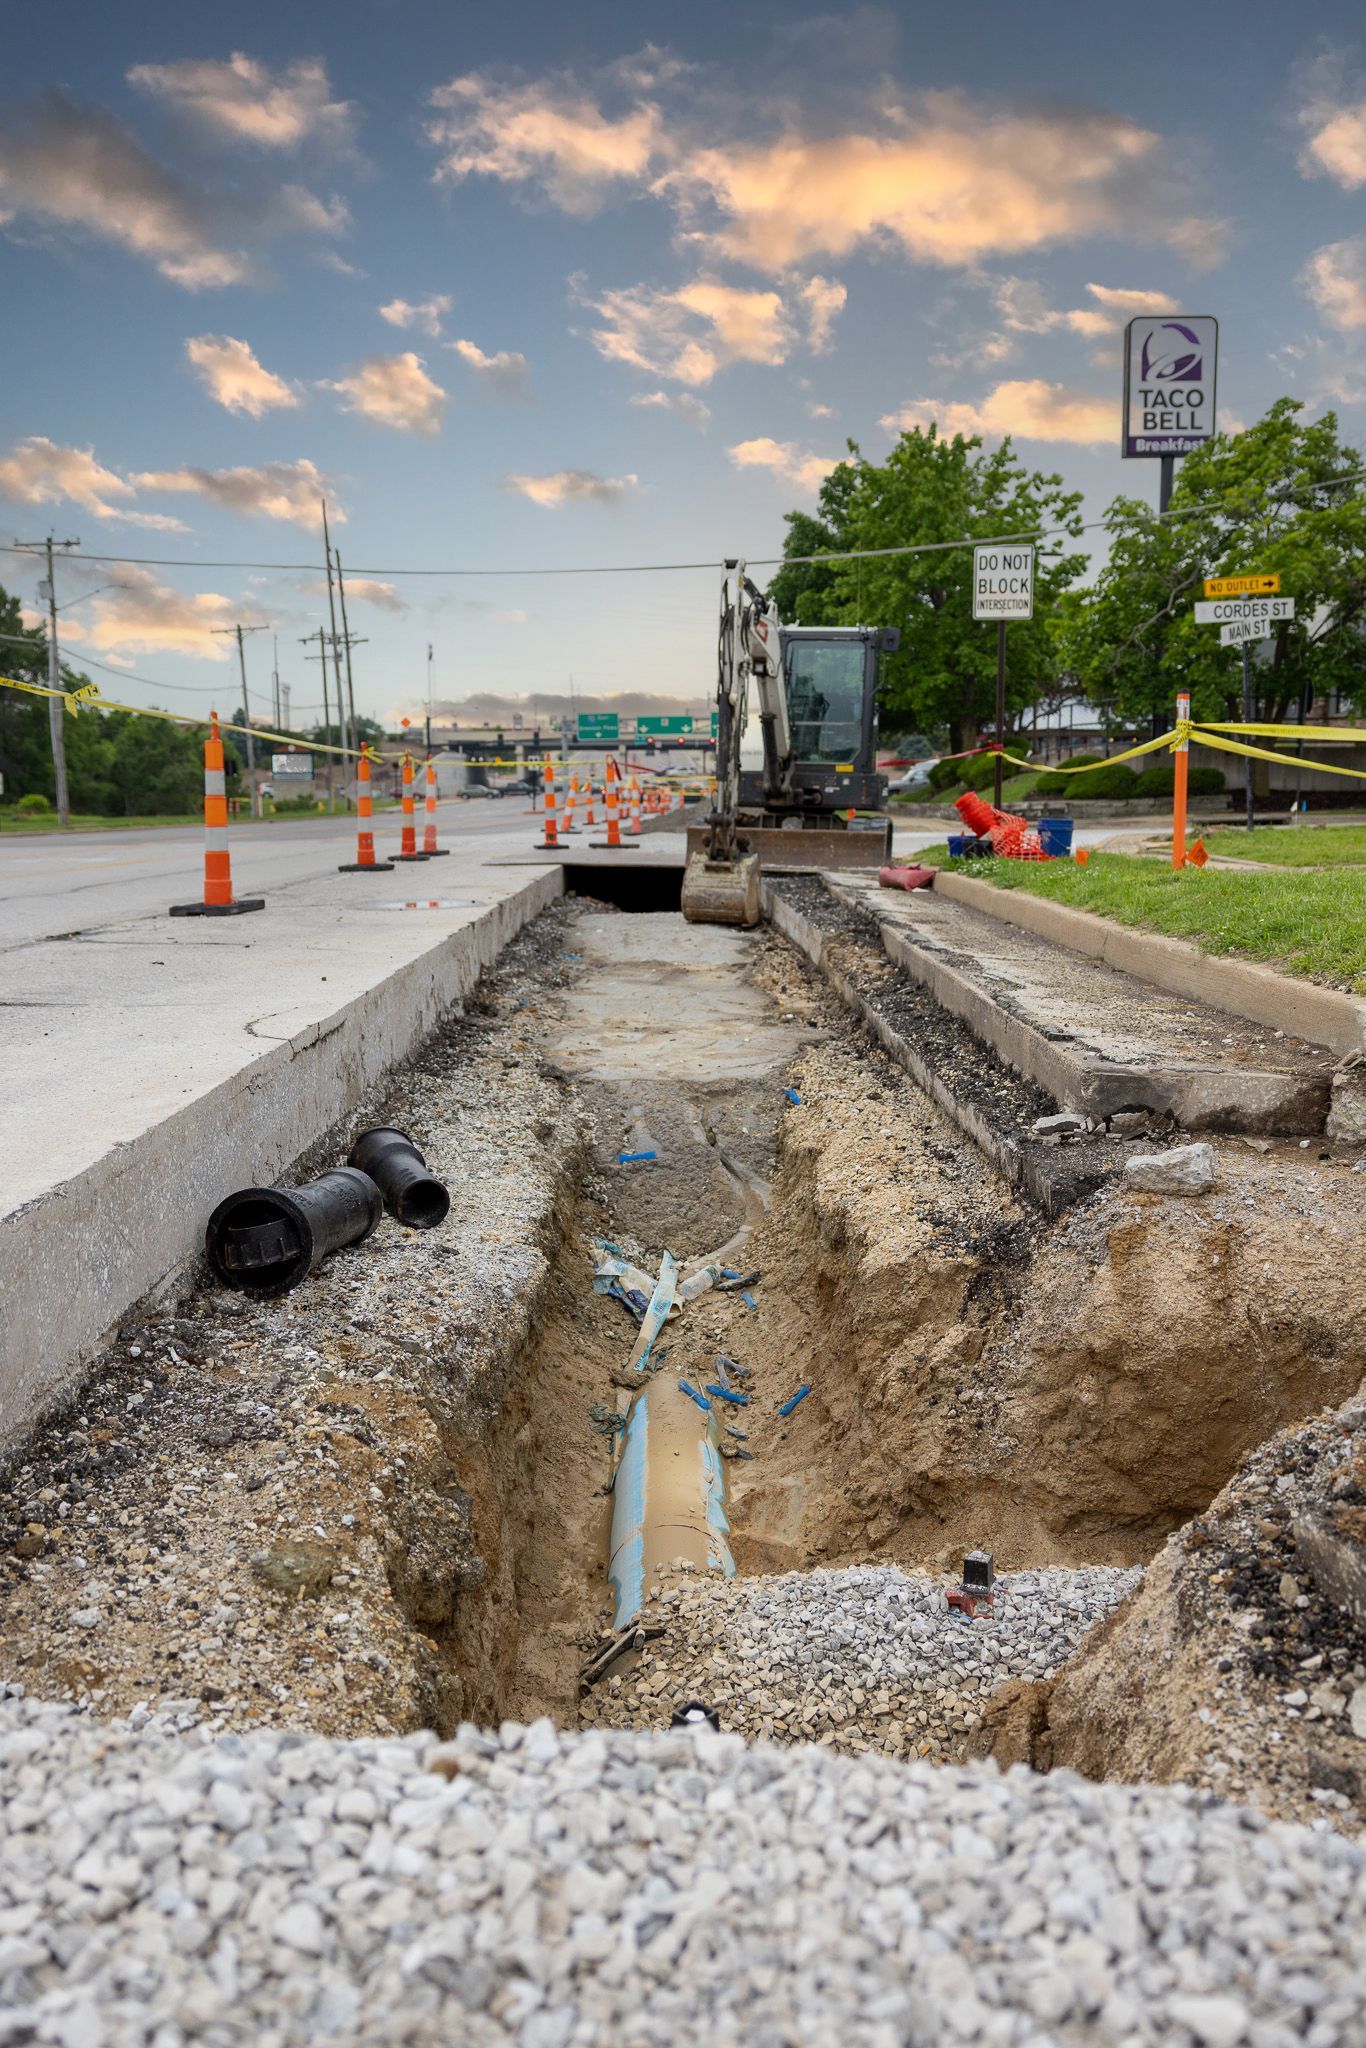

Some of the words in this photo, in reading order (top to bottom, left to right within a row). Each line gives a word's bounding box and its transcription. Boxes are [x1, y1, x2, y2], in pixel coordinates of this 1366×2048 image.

[1138, 389, 1204, 409] TACO
[1143, 411, 1203, 430] BELL
[979, 555, 998, 571] DO
[1003, 554, 1030, 570] NOT
[978, 578, 1029, 594] BLOCK
[1210, 583, 1223, 592] NO
[1227, 580, 1259, 591] OUTLET
[977, 599, 1029, 610] INTERSECTION
[1214, 603, 1268, 618] CORDES
[1272, 602, 1288, 616] ST
[1229, 624, 1251, 640] MAIN
[1254, 619, 1267, 634] ST
